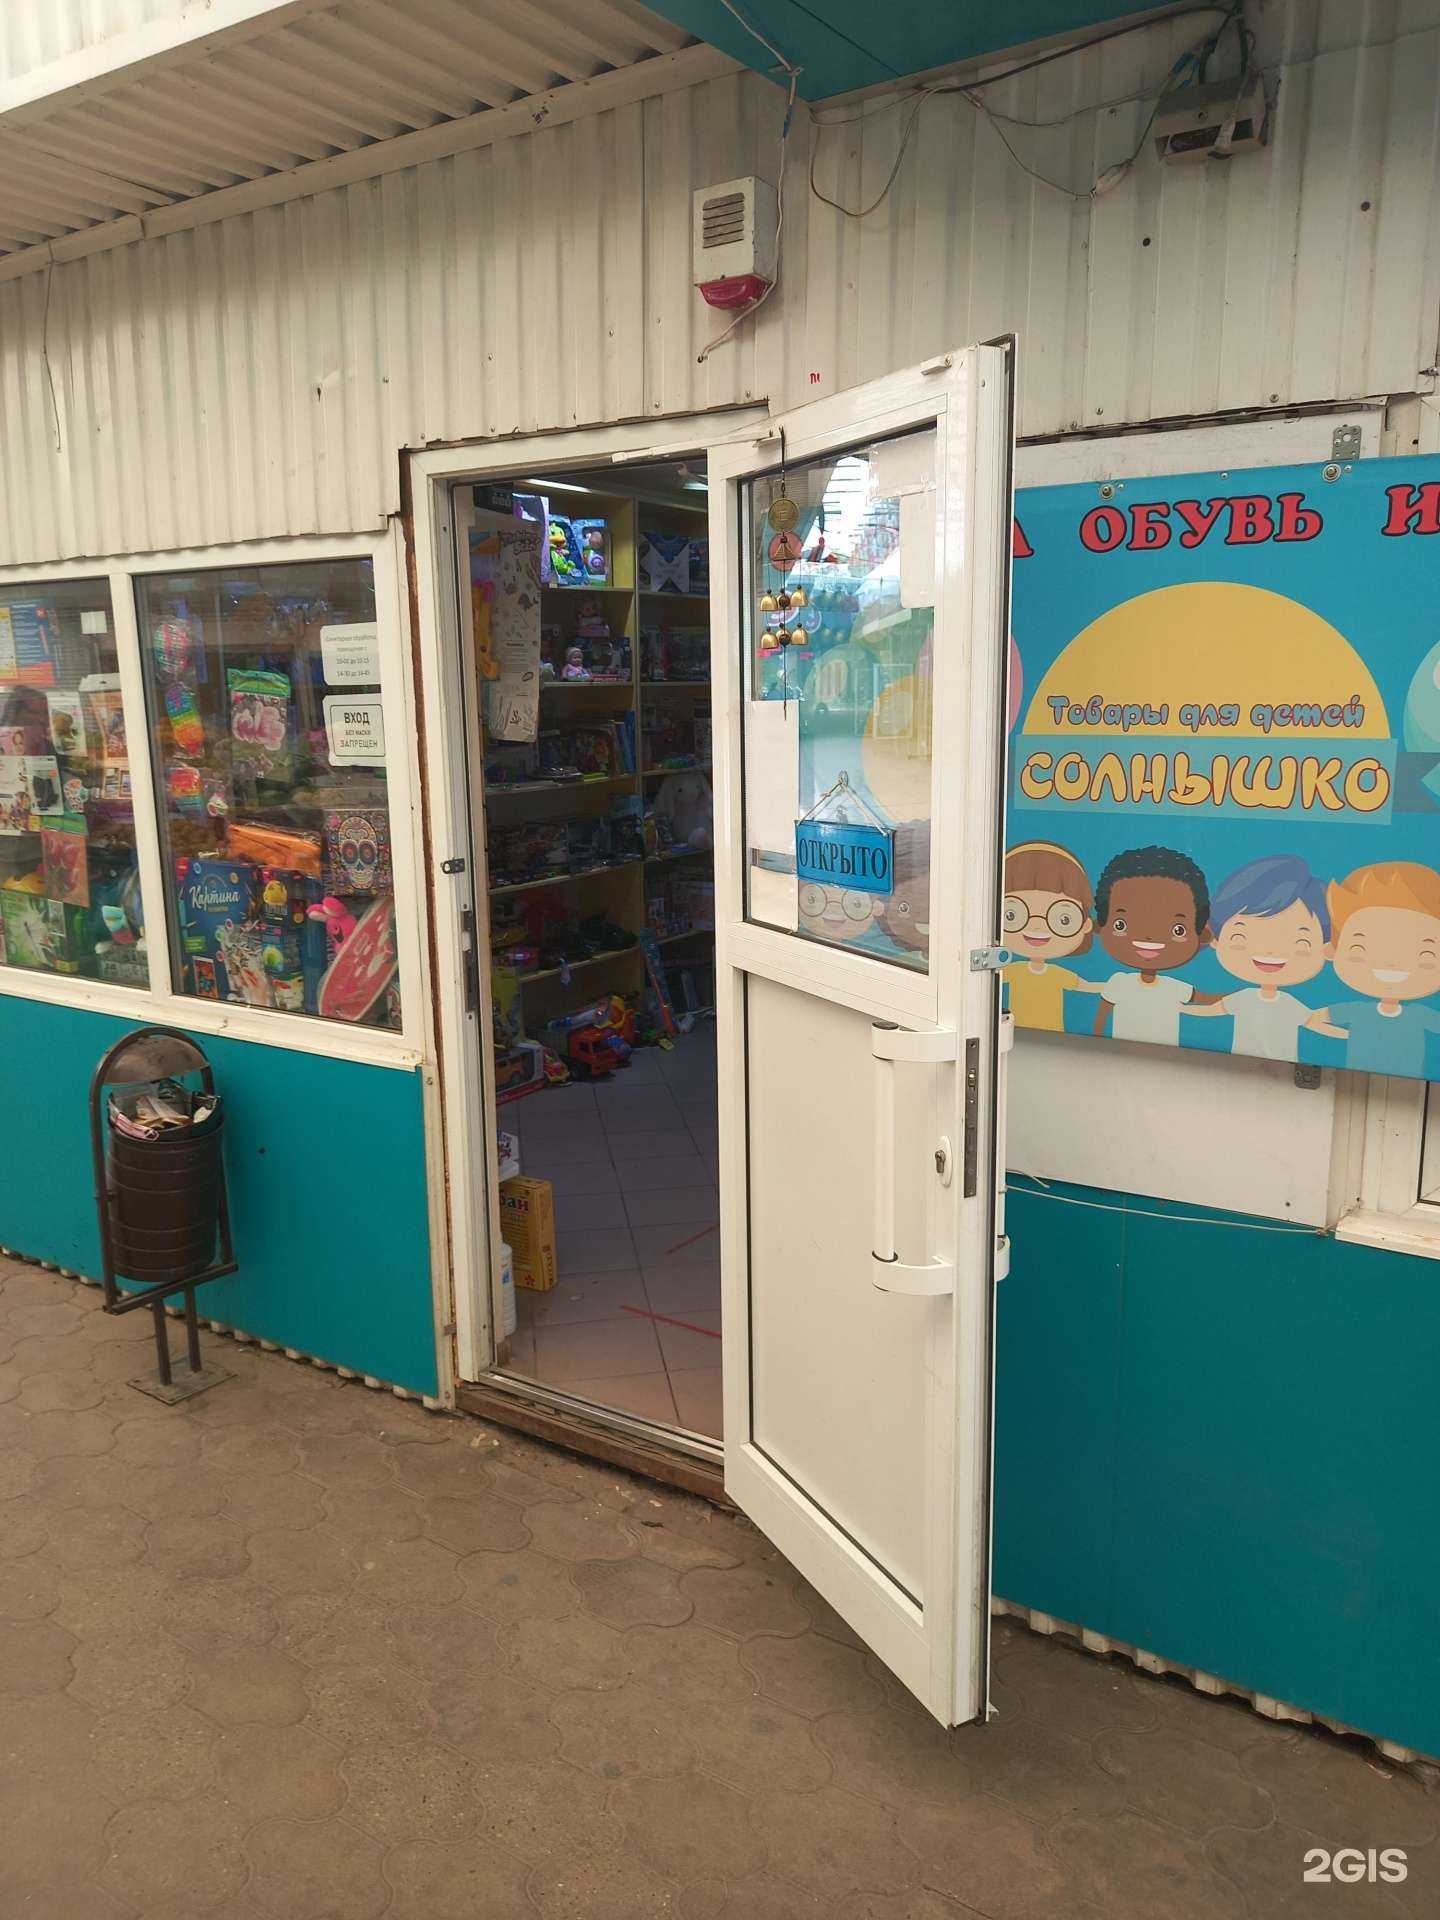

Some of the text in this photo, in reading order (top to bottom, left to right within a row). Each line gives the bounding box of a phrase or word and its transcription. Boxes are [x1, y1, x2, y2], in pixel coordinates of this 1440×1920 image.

[1079, 493, 1323, 553] ОБУВЬ
[344, 711, 370, 726] ВХОД
[1047, 694, 1365, 733] Товары для детей
[339, 739, 378, 749] ЗАПРЕЩЕН
[1020, 751, 1390, 812] СОЛНЫШКО
[799, 838, 888, 880] ОТКРЫТО
[189, 885, 240, 912] Картина
